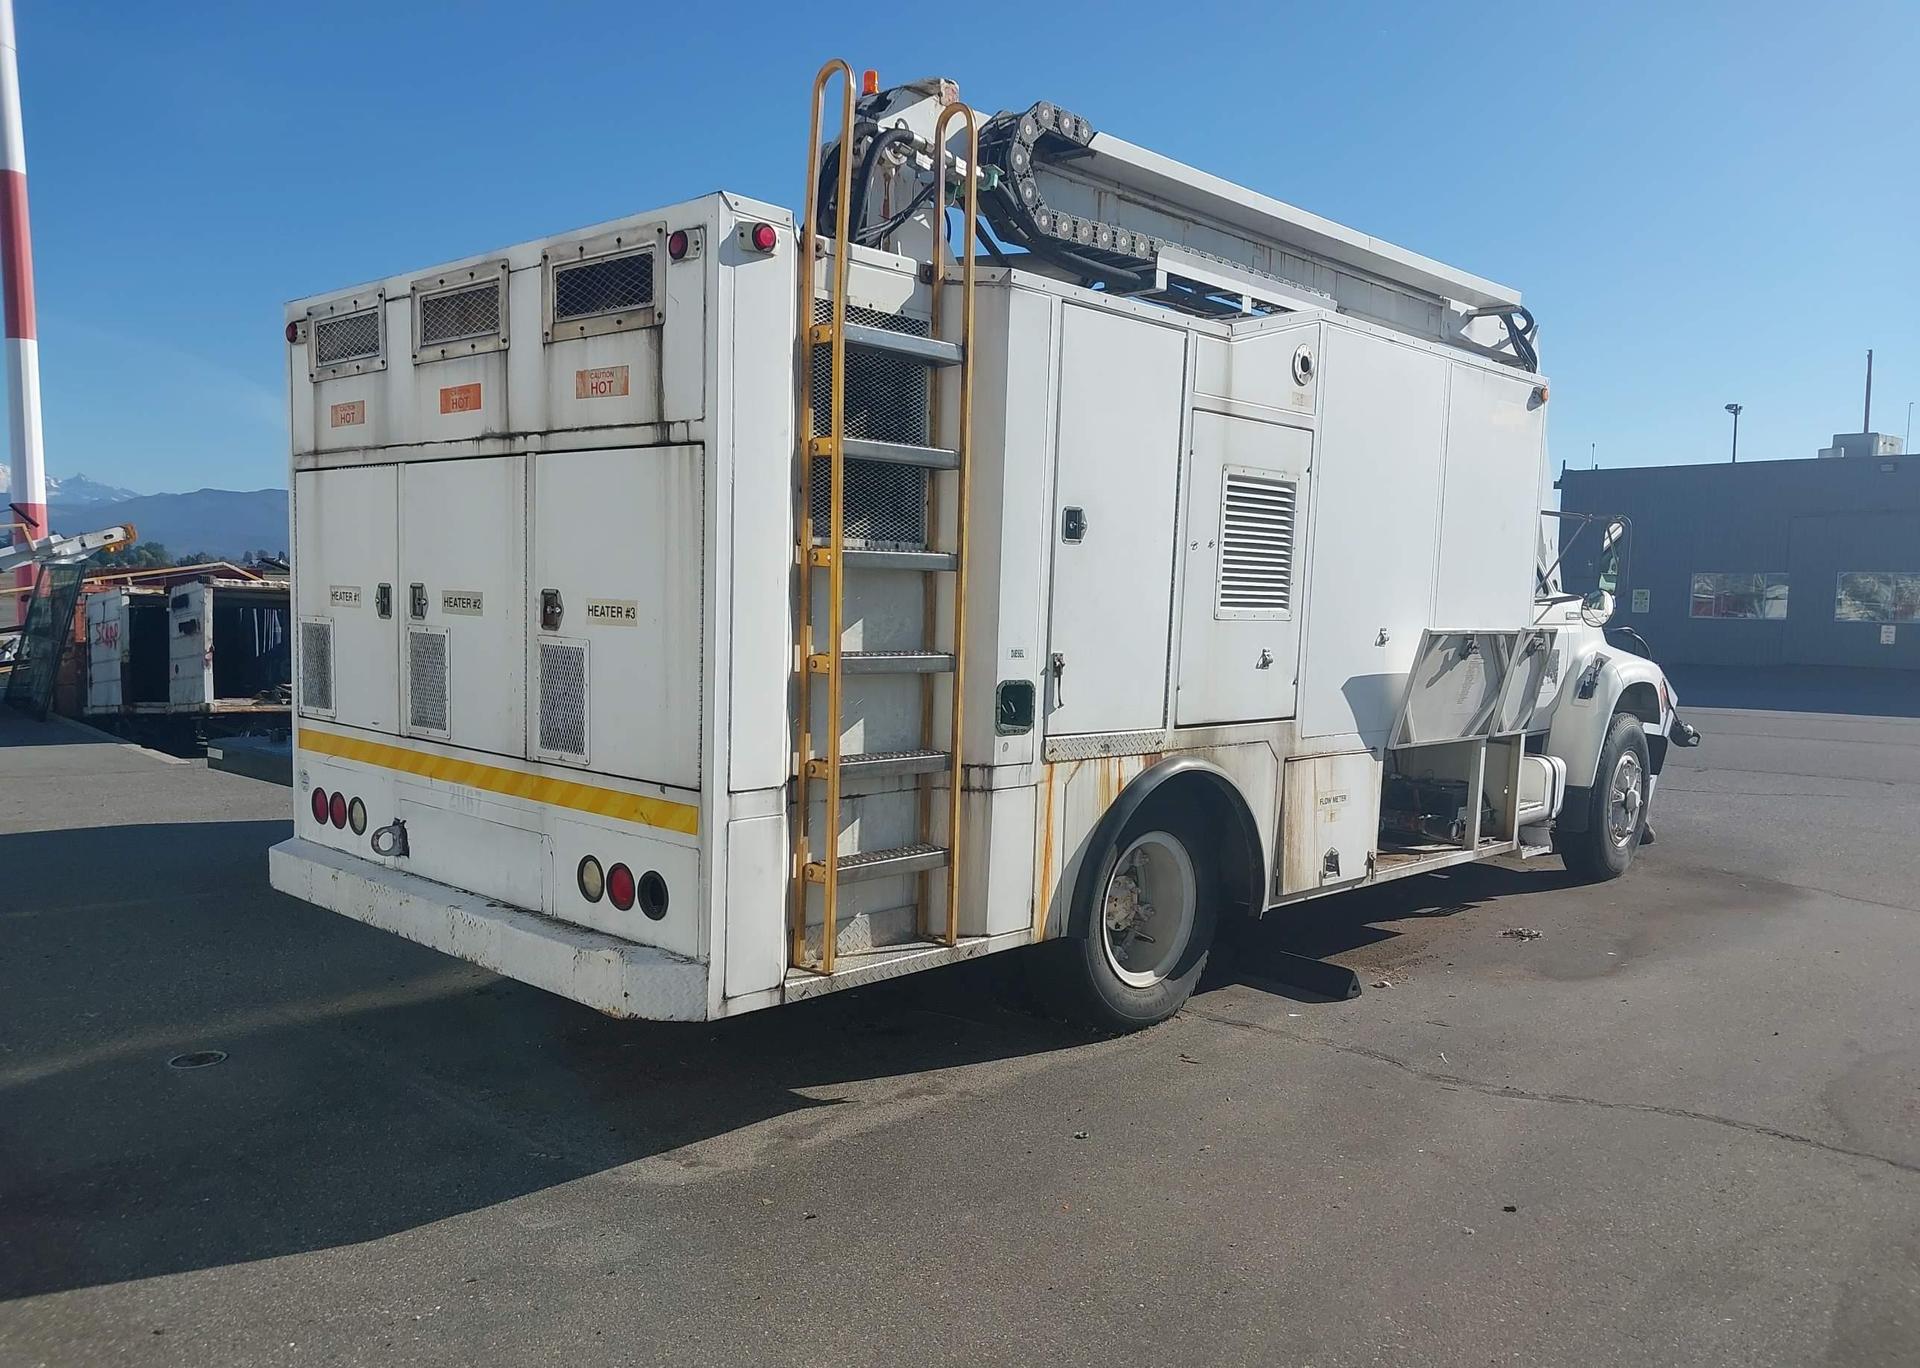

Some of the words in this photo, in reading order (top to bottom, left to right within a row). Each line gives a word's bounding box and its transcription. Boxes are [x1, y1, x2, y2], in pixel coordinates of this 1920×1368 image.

[590, 370, 615, 379] CAUTION
[591, 380, 614, 395] HOT
[451, 396, 469, 410] HOT
[340, 412, 356, 424] HOT
[331, 590, 353, 602] HEATER
[443, 596, 472, 609] HEATER
[472, 598, 482, 610] #2
[587, 604, 623, 618] HEATER
[625, 607, 636, 619] #3
[1319, 797, 1332, 805] FLOW
[1332, 794, 1347, 804] METER
